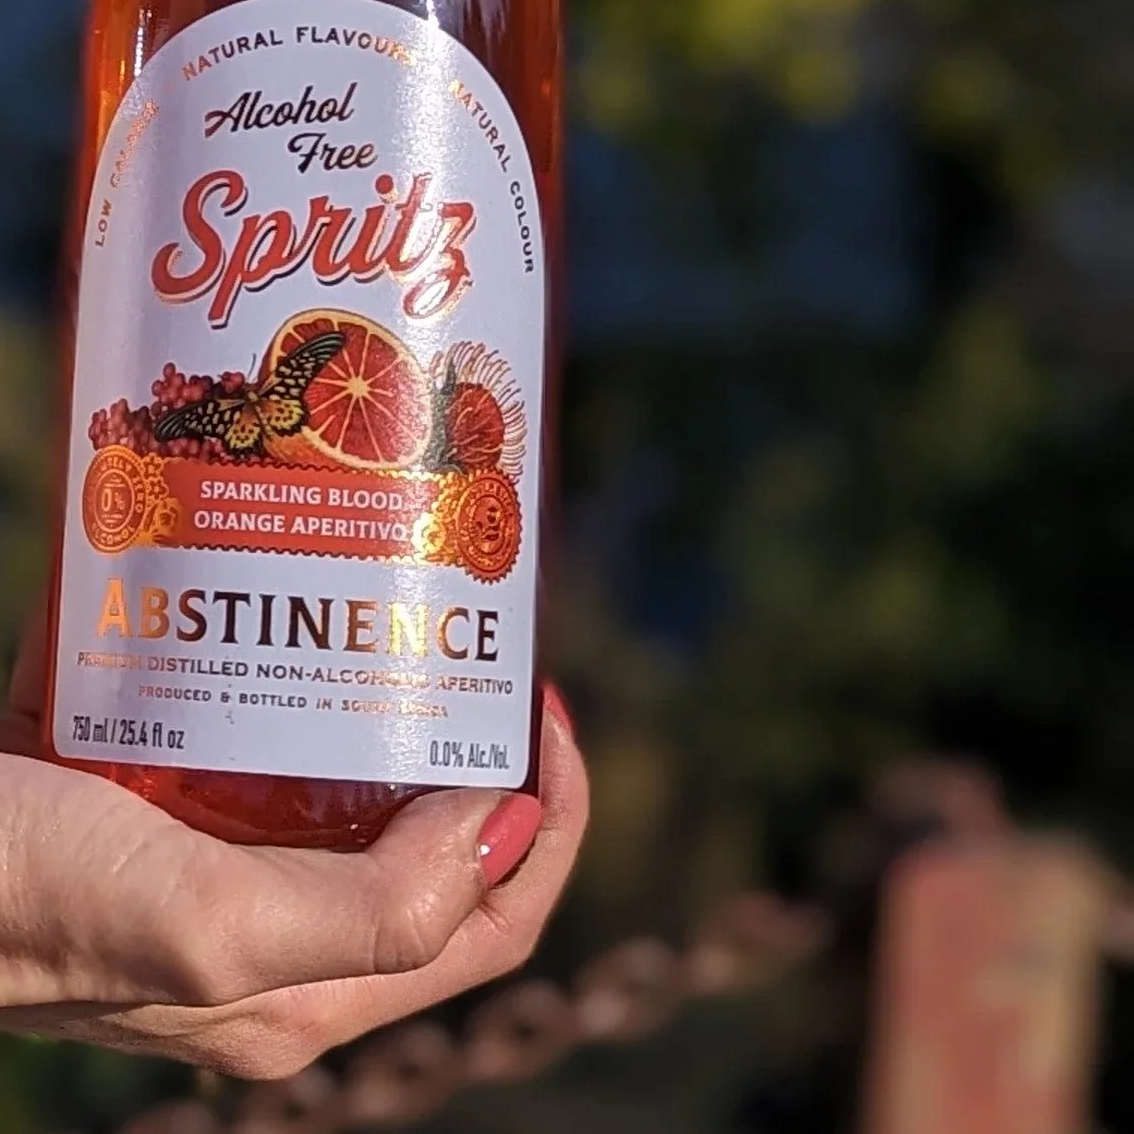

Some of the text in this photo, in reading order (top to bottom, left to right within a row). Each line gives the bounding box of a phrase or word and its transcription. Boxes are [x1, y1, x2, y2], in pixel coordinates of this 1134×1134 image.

[205, 81, 359, 139] Alcohol
[181, 29, 284, 82] NATURAL
[448, 79, 515, 173] NATURAL
[509, 180, 535, 274] COLOUR
[287, 132, 379, 174] Free
[95, 199, 112, 247] LOW
[151, 169, 477, 330] Spritz
[200, 480, 404, 511] SPARKLING BLOOD
[194, 510, 409, 542] ORANGE APERITIVO
[94, 575, 500, 663] ABSTINENCE
[147, 655, 249, 678] DISTILLED
[435, 674, 514, 695] APERITIVO
[138, 684, 213, 703] PRODUCED
[238, 693, 307, 709] BOTTLED
[316, 697, 332, 710] IN
[73, 715, 91, 742] 750
[119, 719, 148, 747] 25.4
[152, 722, 163, 749] fl
[167, 730, 186, 750] oz
[429, 740, 465, 768] 0.0%
